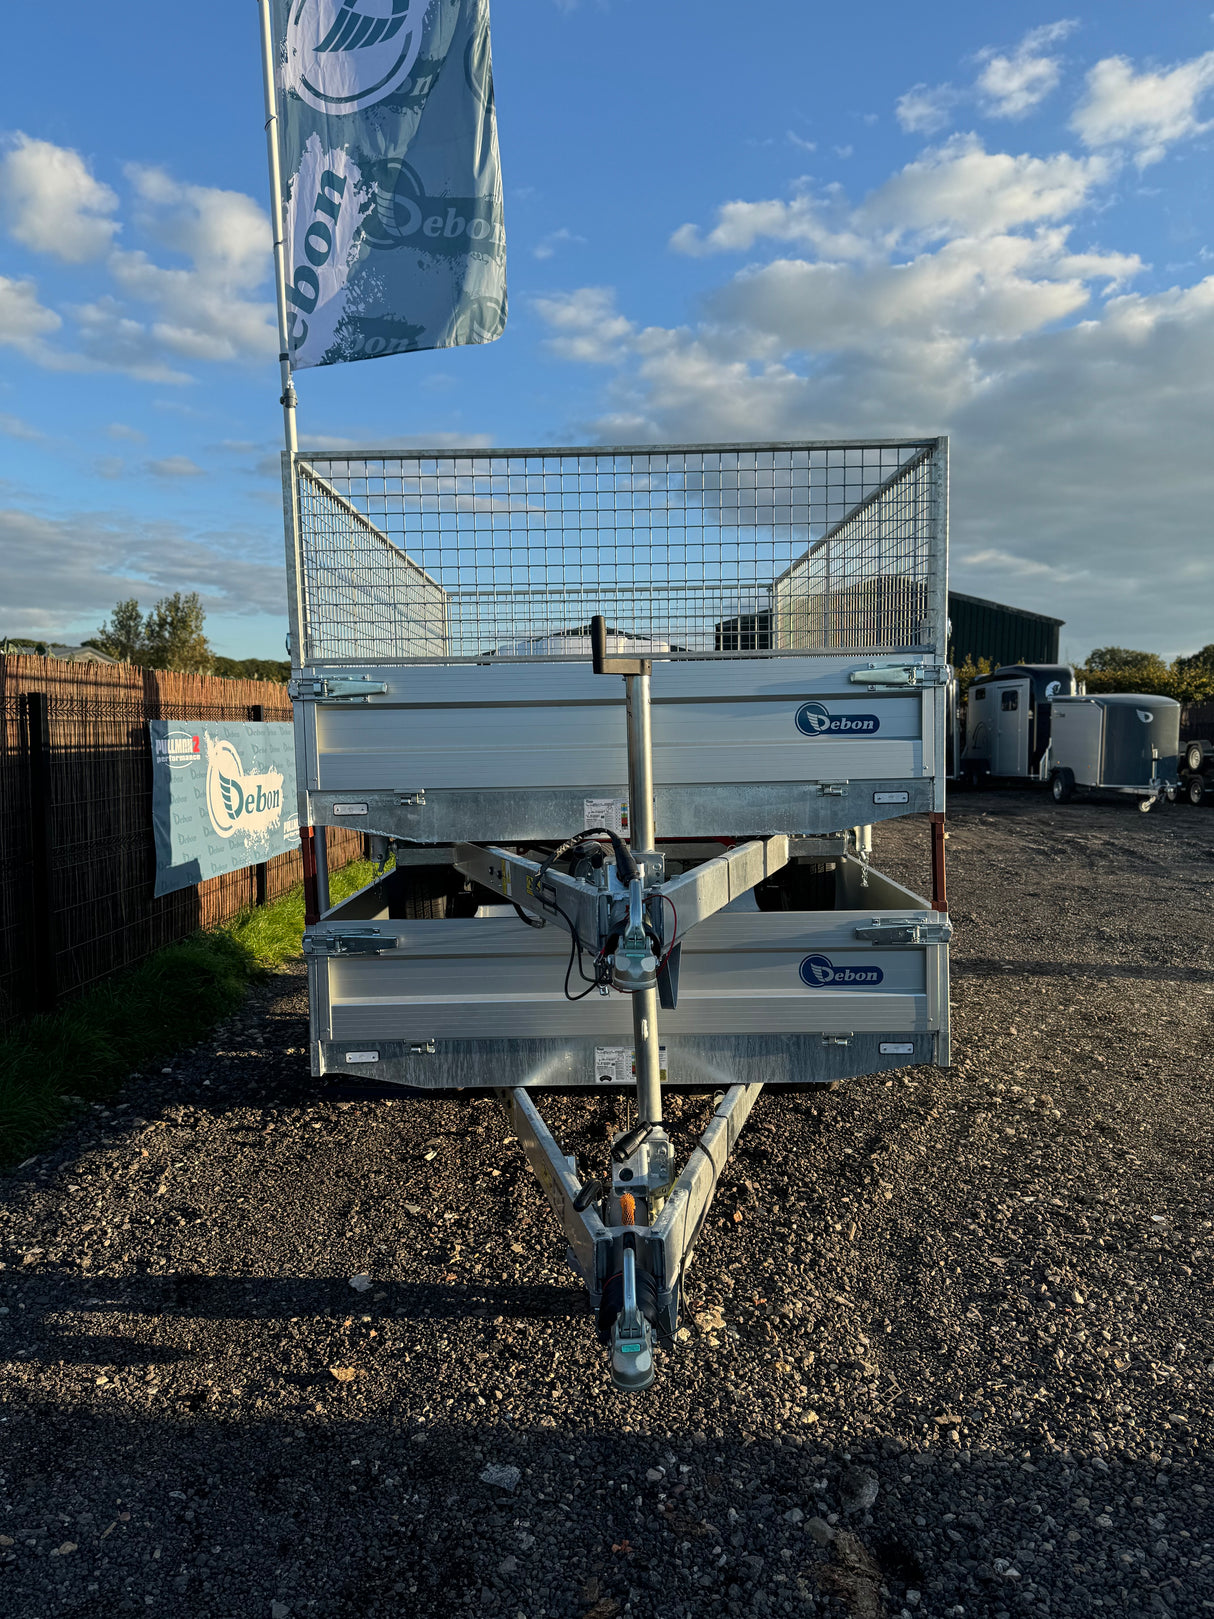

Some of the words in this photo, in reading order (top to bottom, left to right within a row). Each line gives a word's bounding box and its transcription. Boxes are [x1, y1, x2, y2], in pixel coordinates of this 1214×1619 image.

[807, 711, 874, 732] Debon
[218, 770, 280, 820] Debon
[811, 963, 878, 984] Debon
